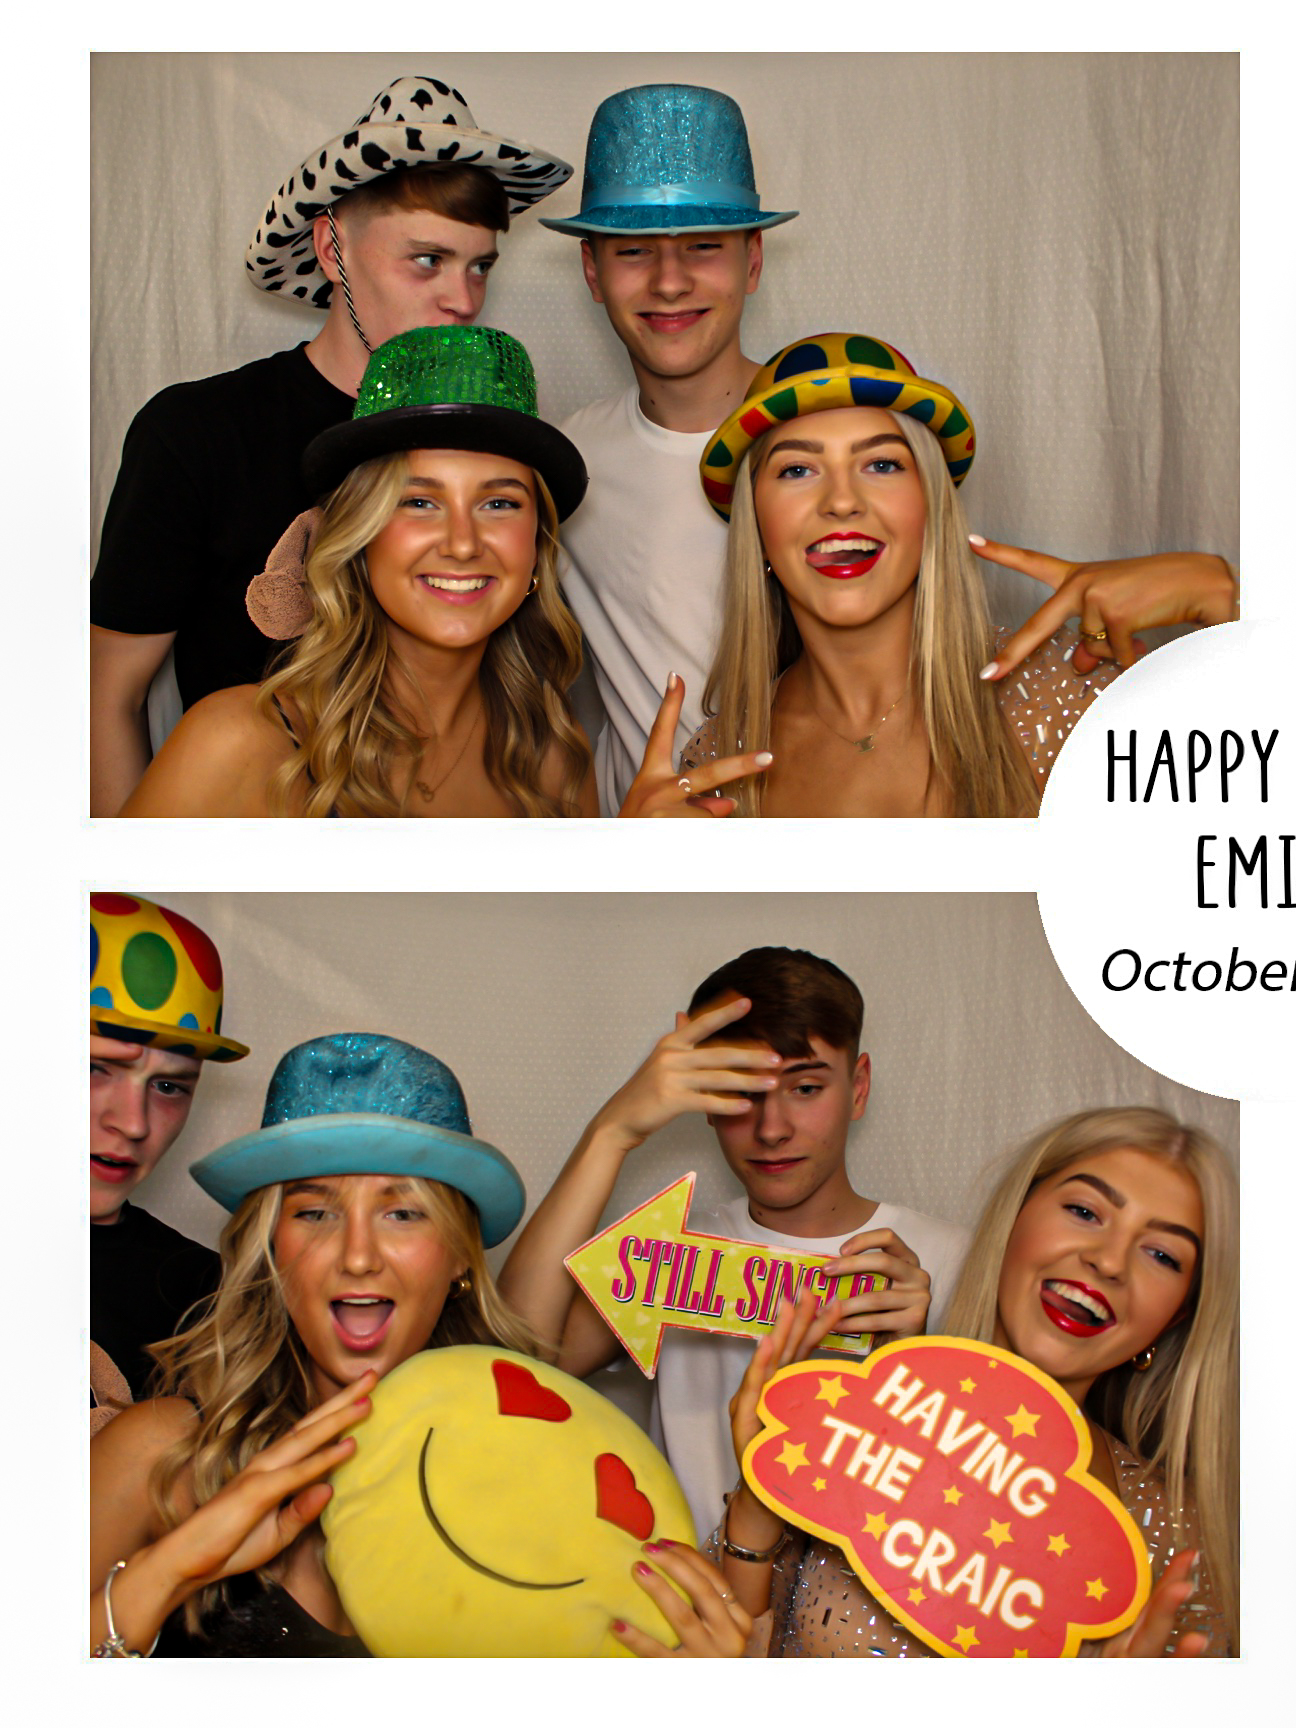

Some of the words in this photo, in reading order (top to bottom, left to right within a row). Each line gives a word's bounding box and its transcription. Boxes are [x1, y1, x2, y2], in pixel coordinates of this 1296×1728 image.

[611, 1235, 724, 1318] STILL
[819, 1415, 925, 1503] THE
[871, 1363, 1057, 1518] HAVING
[881, 1518, 1044, 1631] CRAIC
